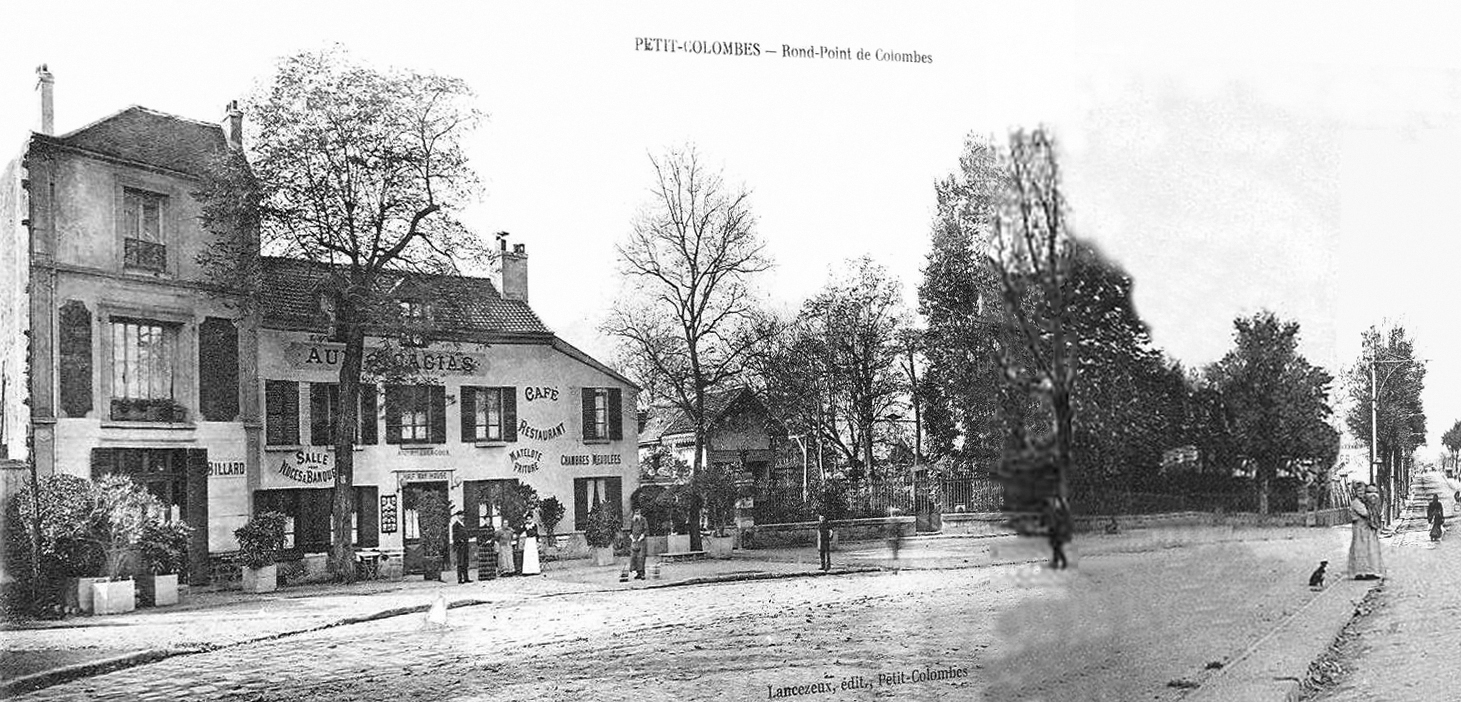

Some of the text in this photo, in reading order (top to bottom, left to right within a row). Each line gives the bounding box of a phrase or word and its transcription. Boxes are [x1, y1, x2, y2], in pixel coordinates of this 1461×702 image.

[525, 386, 559, 401] CAFÉ
[518, 419, 566, 441] RESTAURANT
[296, 451, 328, 465] SALLE
[560, 454, 589, 466] CHAMBRES
[207, 462, 245, 476] BILLARD
[279, 459, 303, 482] NOCES
